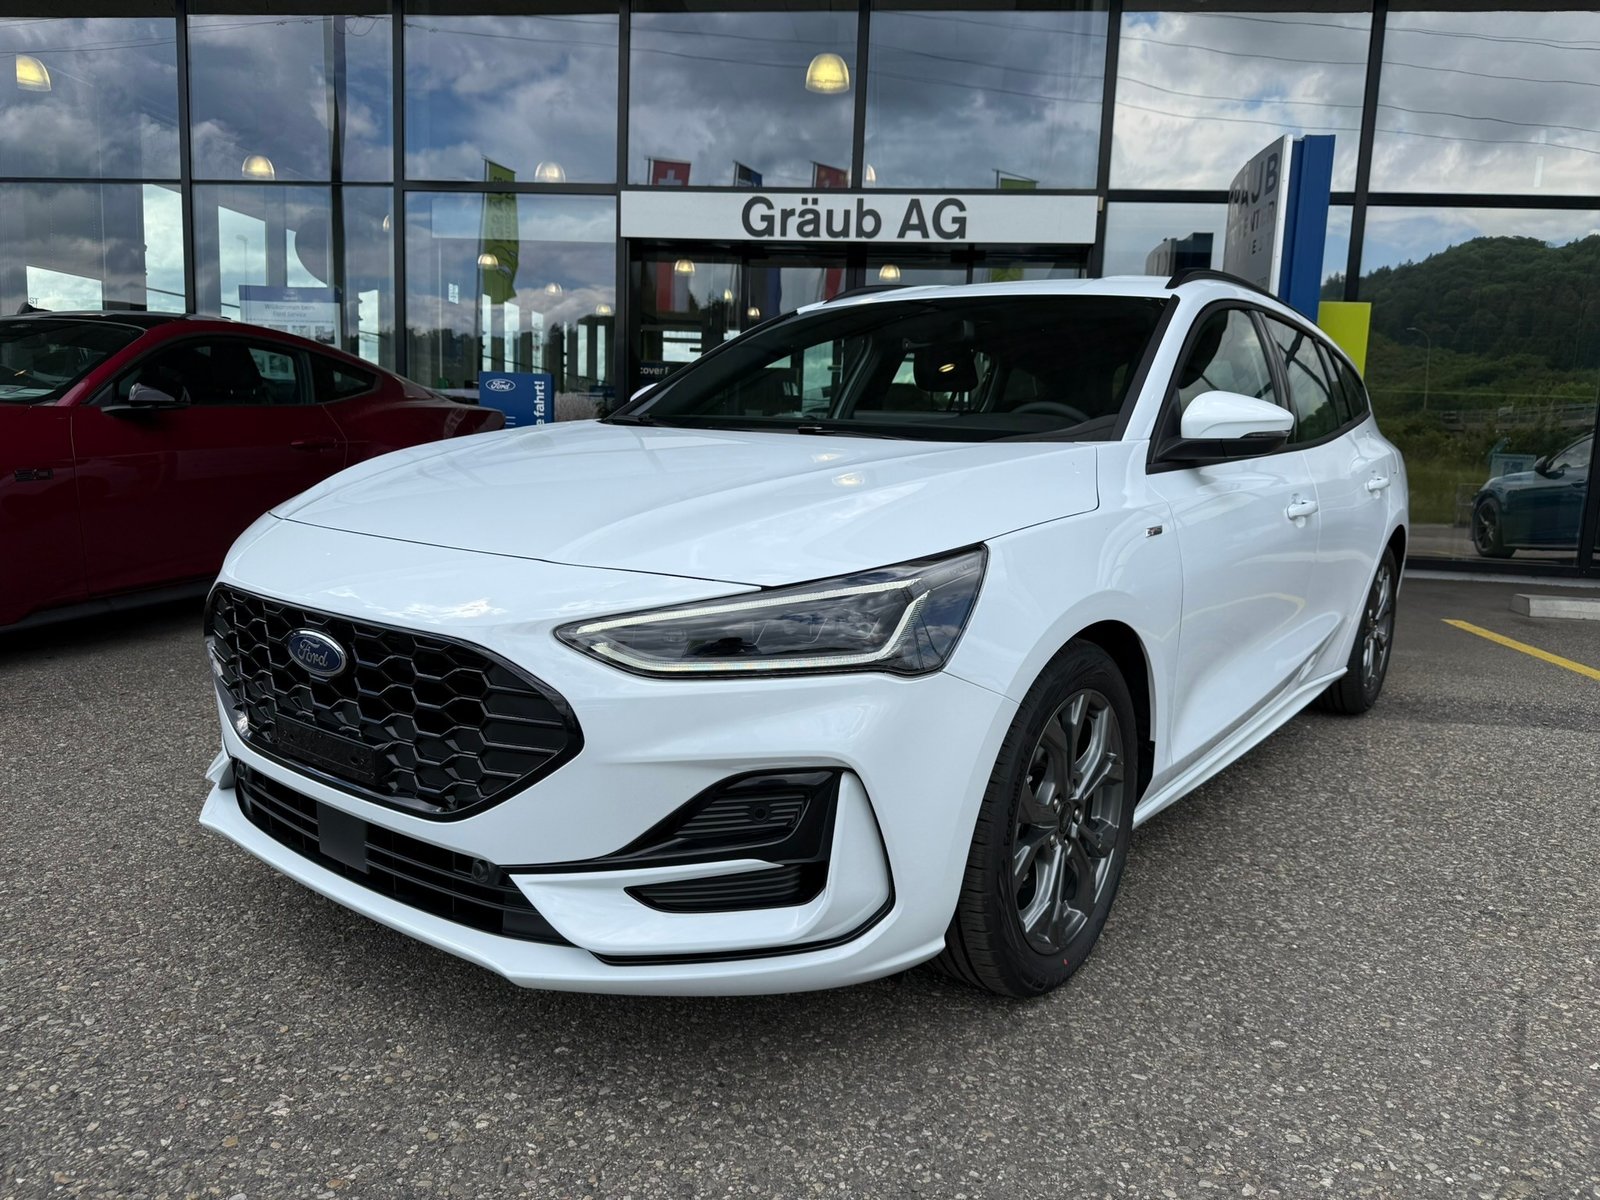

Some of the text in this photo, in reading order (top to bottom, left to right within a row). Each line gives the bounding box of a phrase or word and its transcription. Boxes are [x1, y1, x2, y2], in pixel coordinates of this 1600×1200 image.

[741, 196, 967, 240] Gräub AG
[490, 380, 512, 390] Ford
[534, 380, 545, 417] fahrt!
[297, 639, 329, 667] Ford
